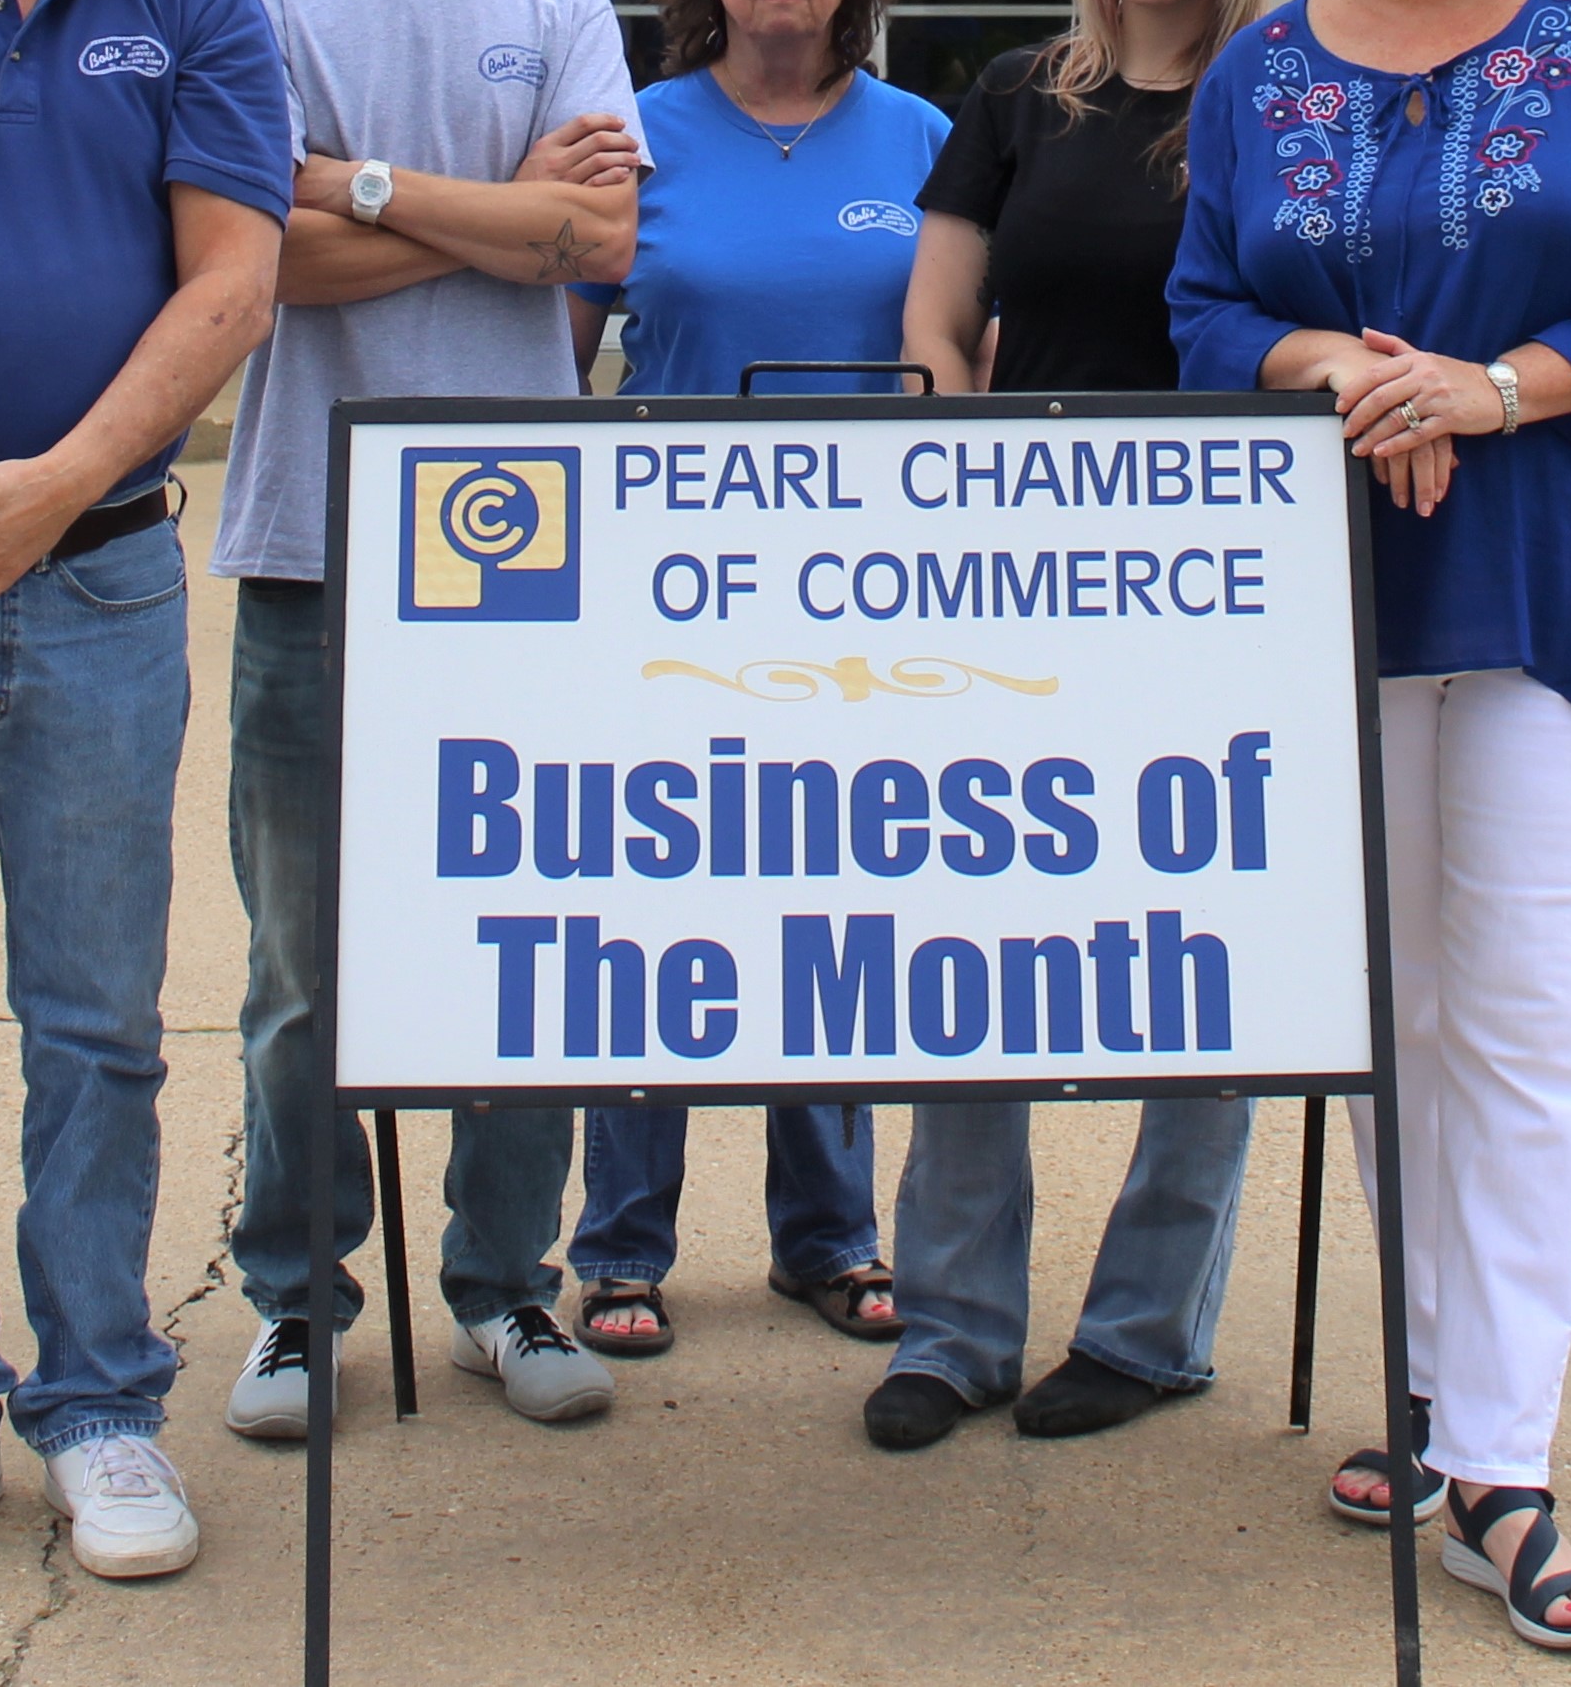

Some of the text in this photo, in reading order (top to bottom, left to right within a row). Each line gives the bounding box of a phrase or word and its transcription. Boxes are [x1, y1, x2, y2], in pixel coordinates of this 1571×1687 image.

[89, 45, 122, 68] Bob's
[613, 439, 1296, 511] PEARL CHAMBER
[650, 547, 1267, 622] OF COMMERCE
[435, 730, 1273, 879] Business of
[476, 909, 1235, 1059] The Month
